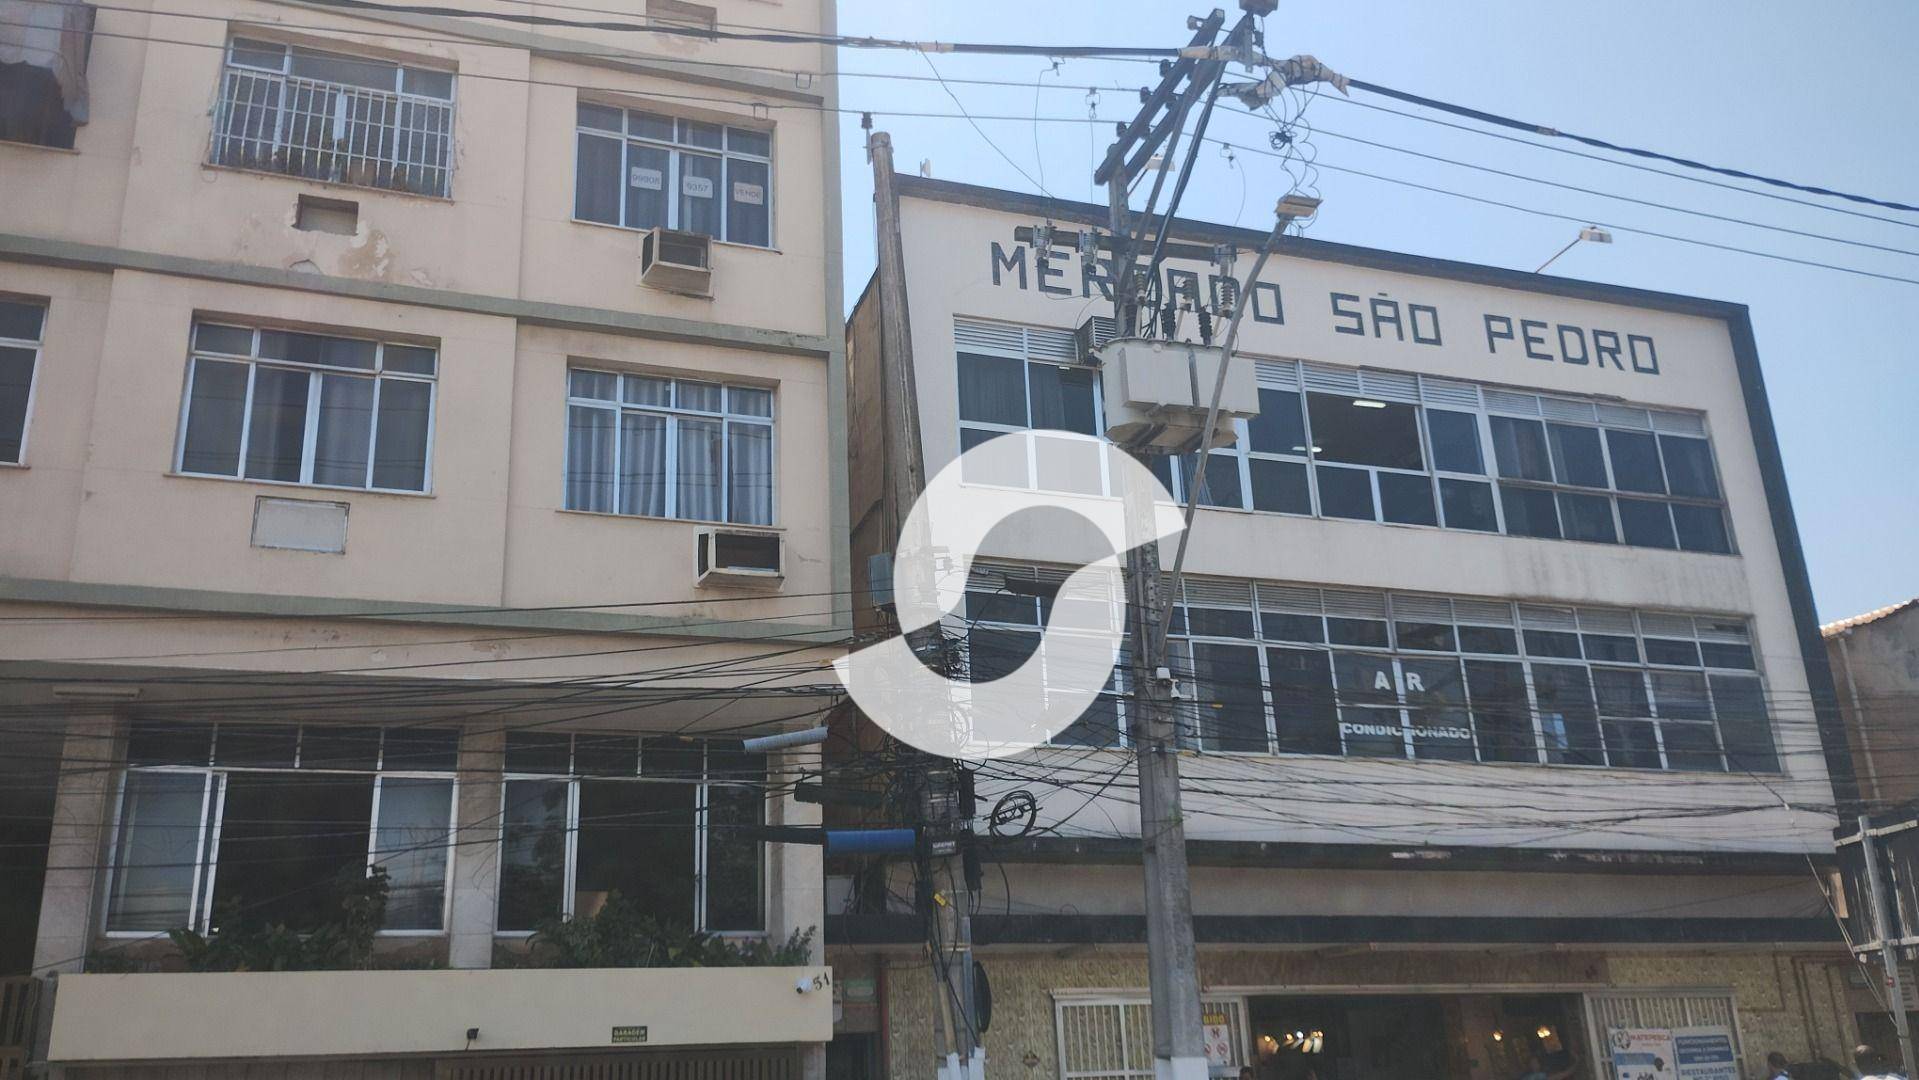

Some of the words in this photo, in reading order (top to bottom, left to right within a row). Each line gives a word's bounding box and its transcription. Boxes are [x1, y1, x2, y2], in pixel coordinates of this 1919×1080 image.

[1330, 292, 1443, 347] SÃO
[1483, 313, 1661, 376] PEDRO
[1374, 670, 1426, 692] AR
[812, 971, 830, 991] 51
